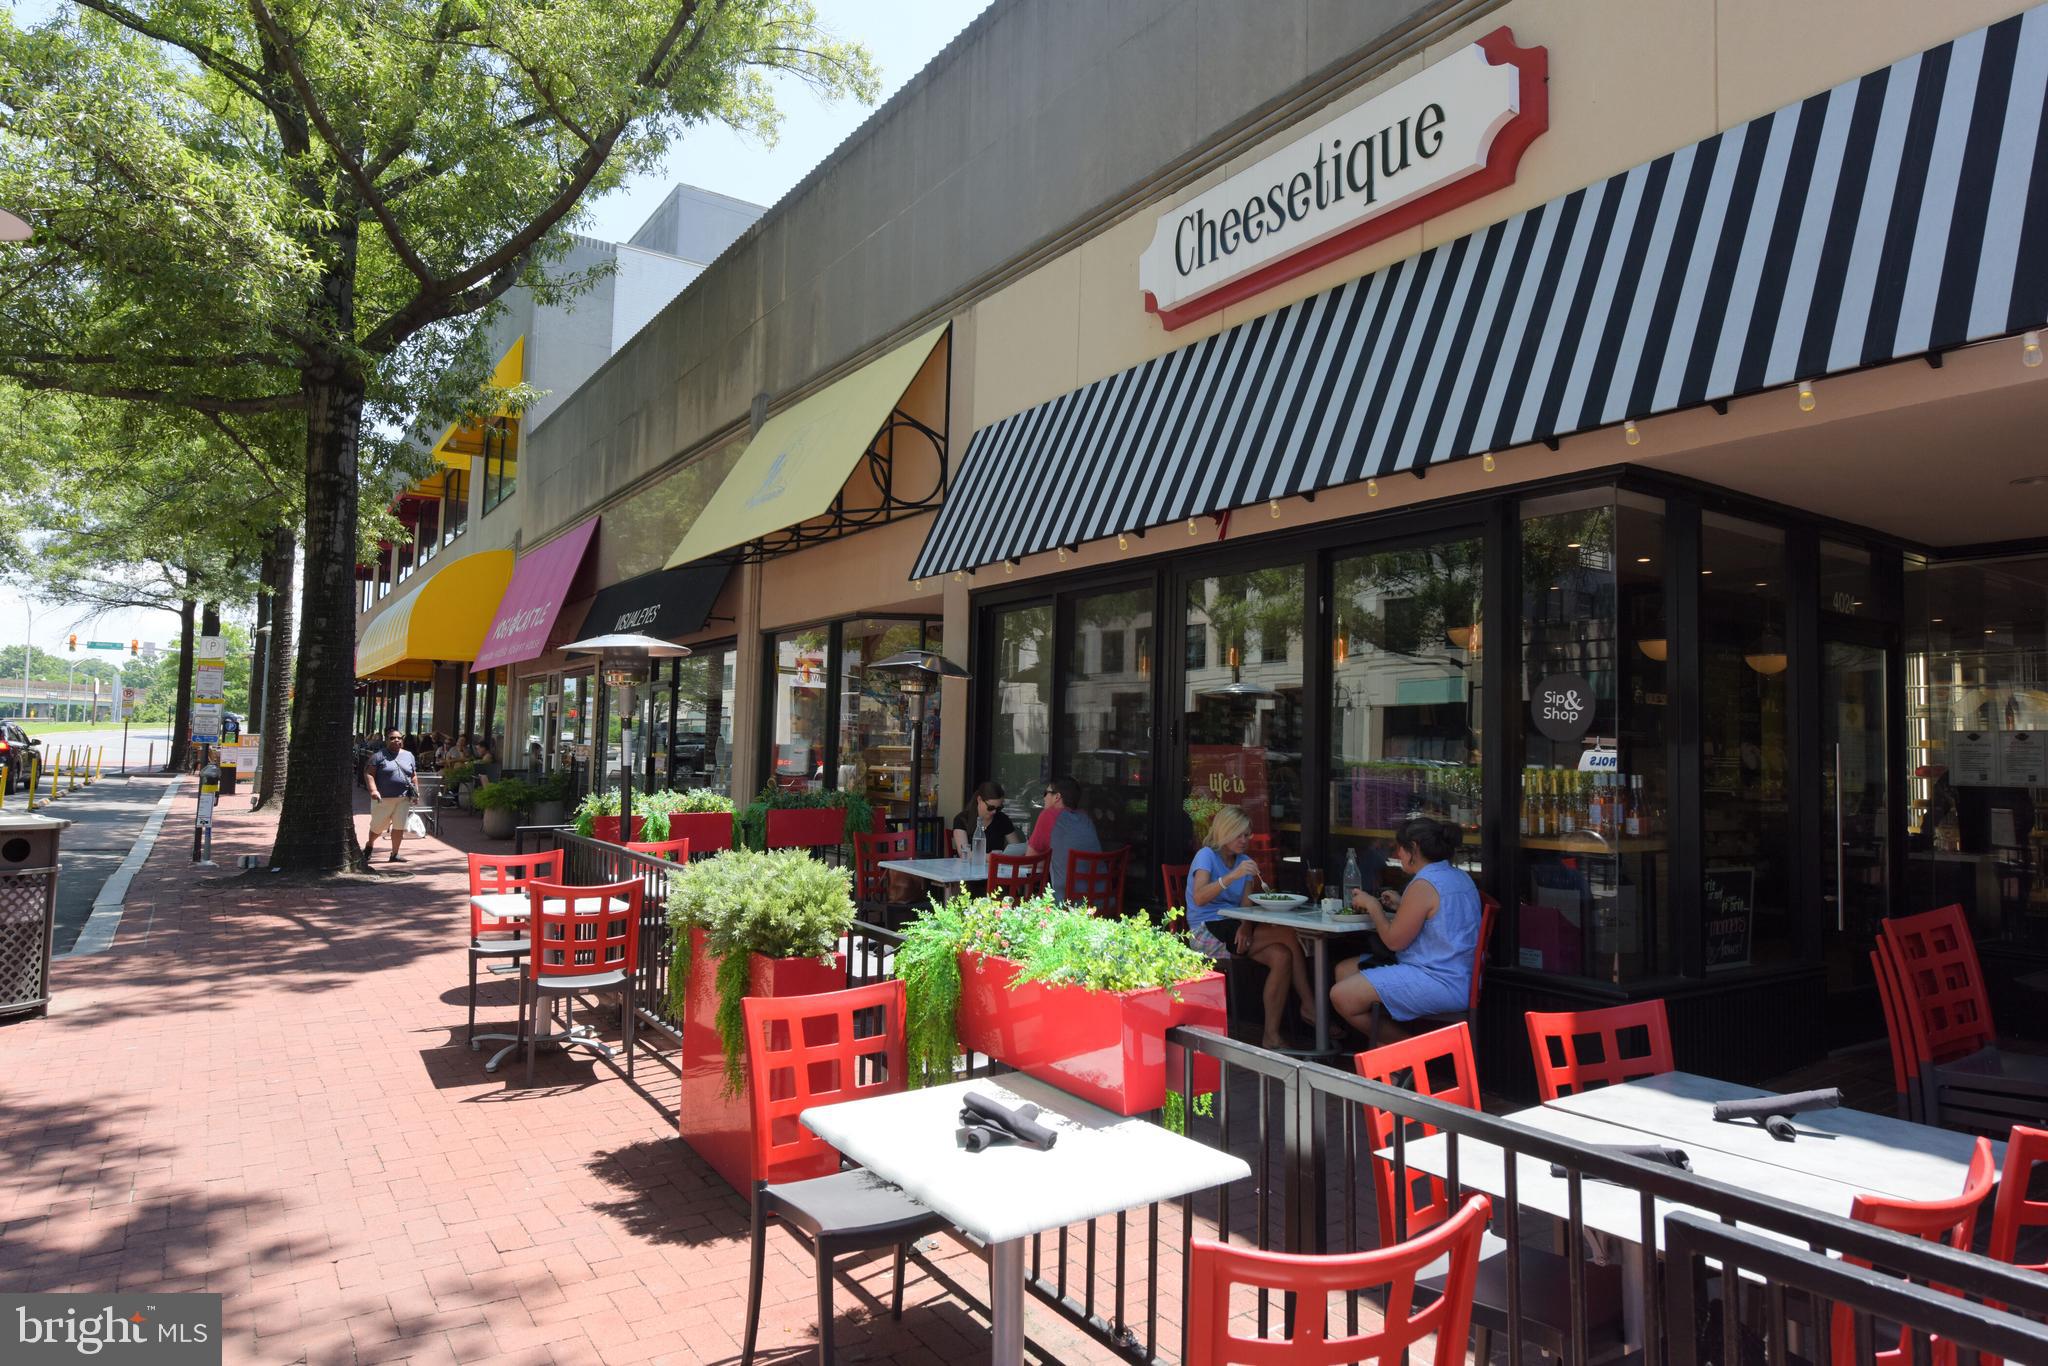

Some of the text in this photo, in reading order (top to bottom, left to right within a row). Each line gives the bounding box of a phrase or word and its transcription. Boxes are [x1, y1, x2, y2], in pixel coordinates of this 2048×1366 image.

[1174, 102, 1446, 276] Cheesetique
[614, 603, 661, 632] VISUALEYES
[1543, 706, 1579, 724] Shop
[1209, 772, 1246, 798] life is
